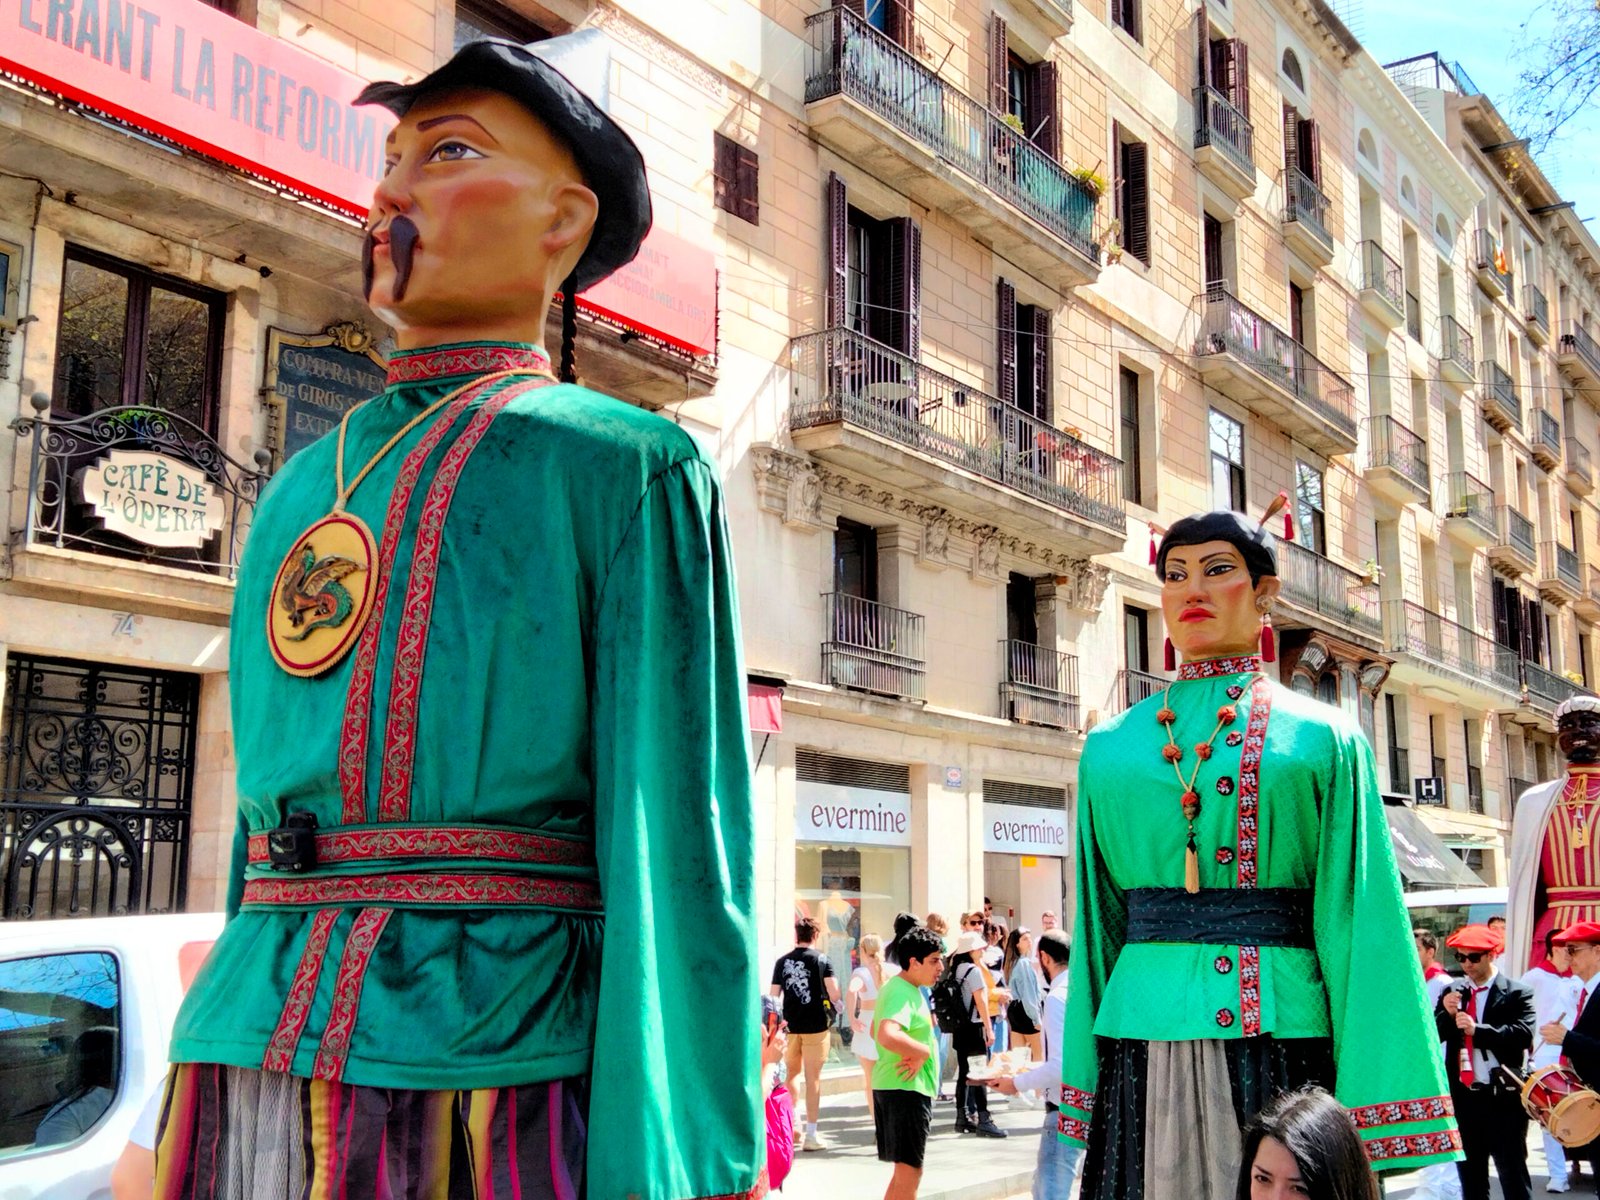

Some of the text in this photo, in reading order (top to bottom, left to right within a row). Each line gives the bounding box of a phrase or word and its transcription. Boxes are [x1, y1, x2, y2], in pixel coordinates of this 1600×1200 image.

[172, 25, 216, 111] LA
[278, 381, 345, 411] DE GIROS
[103, 459, 207, 507] CAFÈ DE
[112, 613, 134, 638] 74
[1421, 779, 1436, 796] H
[811, 802, 906, 834] evermine
[993, 818, 1064, 846] evermine
